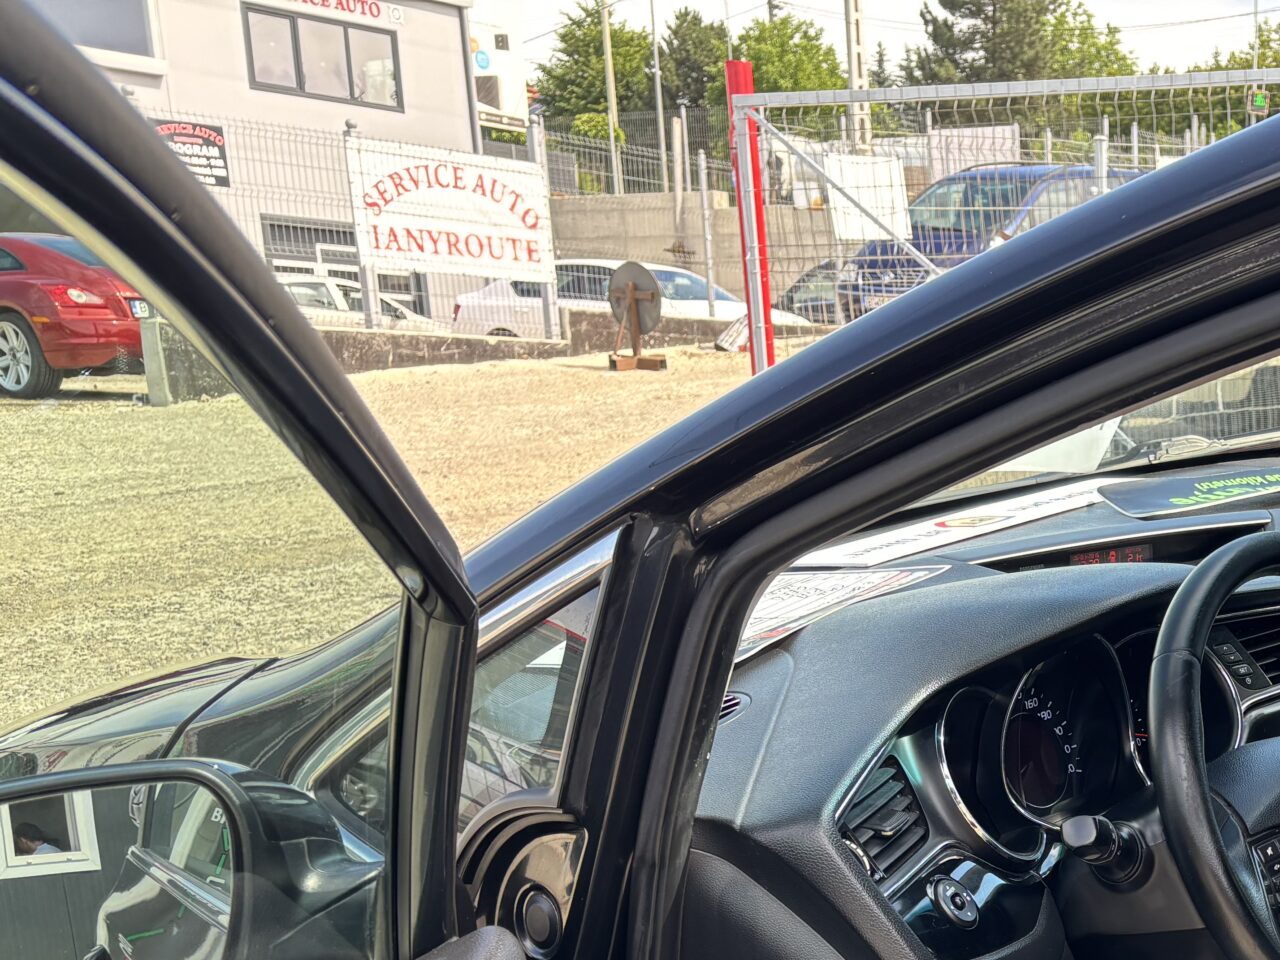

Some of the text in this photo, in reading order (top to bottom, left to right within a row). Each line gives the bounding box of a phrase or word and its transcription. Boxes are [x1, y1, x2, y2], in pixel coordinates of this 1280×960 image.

[194, 126, 224, 146] AUTO
[166, 141, 220, 157] ROGRAM
[362, 164, 540, 230] SERVICE AUTO
[371, 225, 541, 263] IANYROUTE
[1025, 698, 1038, 709] 160
